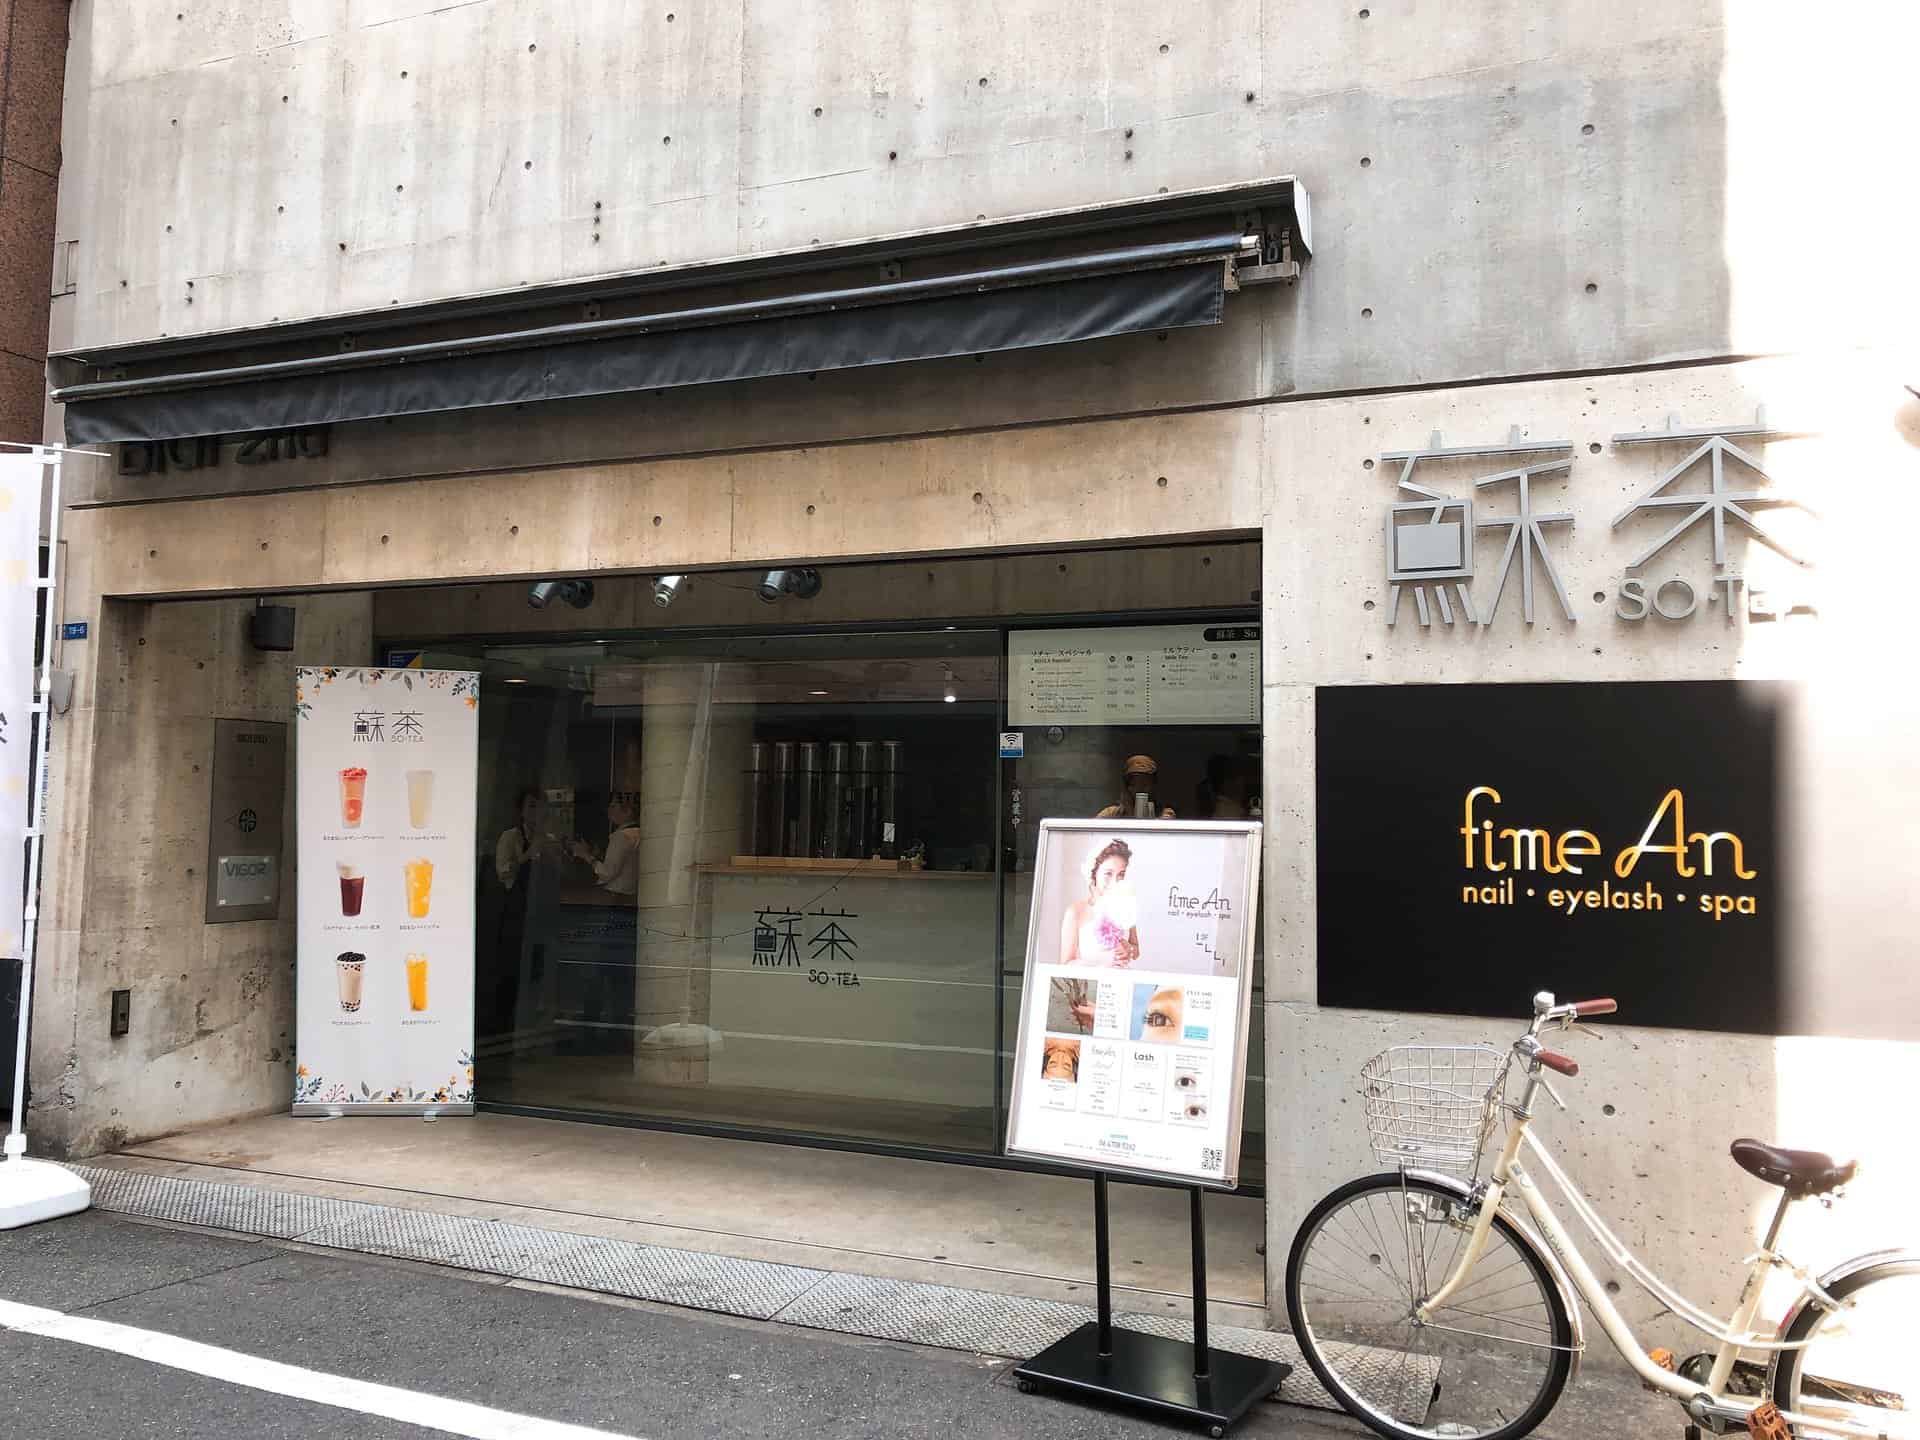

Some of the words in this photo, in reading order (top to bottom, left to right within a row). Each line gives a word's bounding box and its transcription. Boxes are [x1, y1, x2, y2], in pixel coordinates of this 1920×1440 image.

[1460, 786, 1601, 875] fime
[1614, 788, 1757, 880] An
[1462, 877, 1514, 905] nail
[1548, 880, 1663, 915] eyelash
[1699, 893, 1757, 921] spa
[752, 906, 859, 967] 蘇茶
